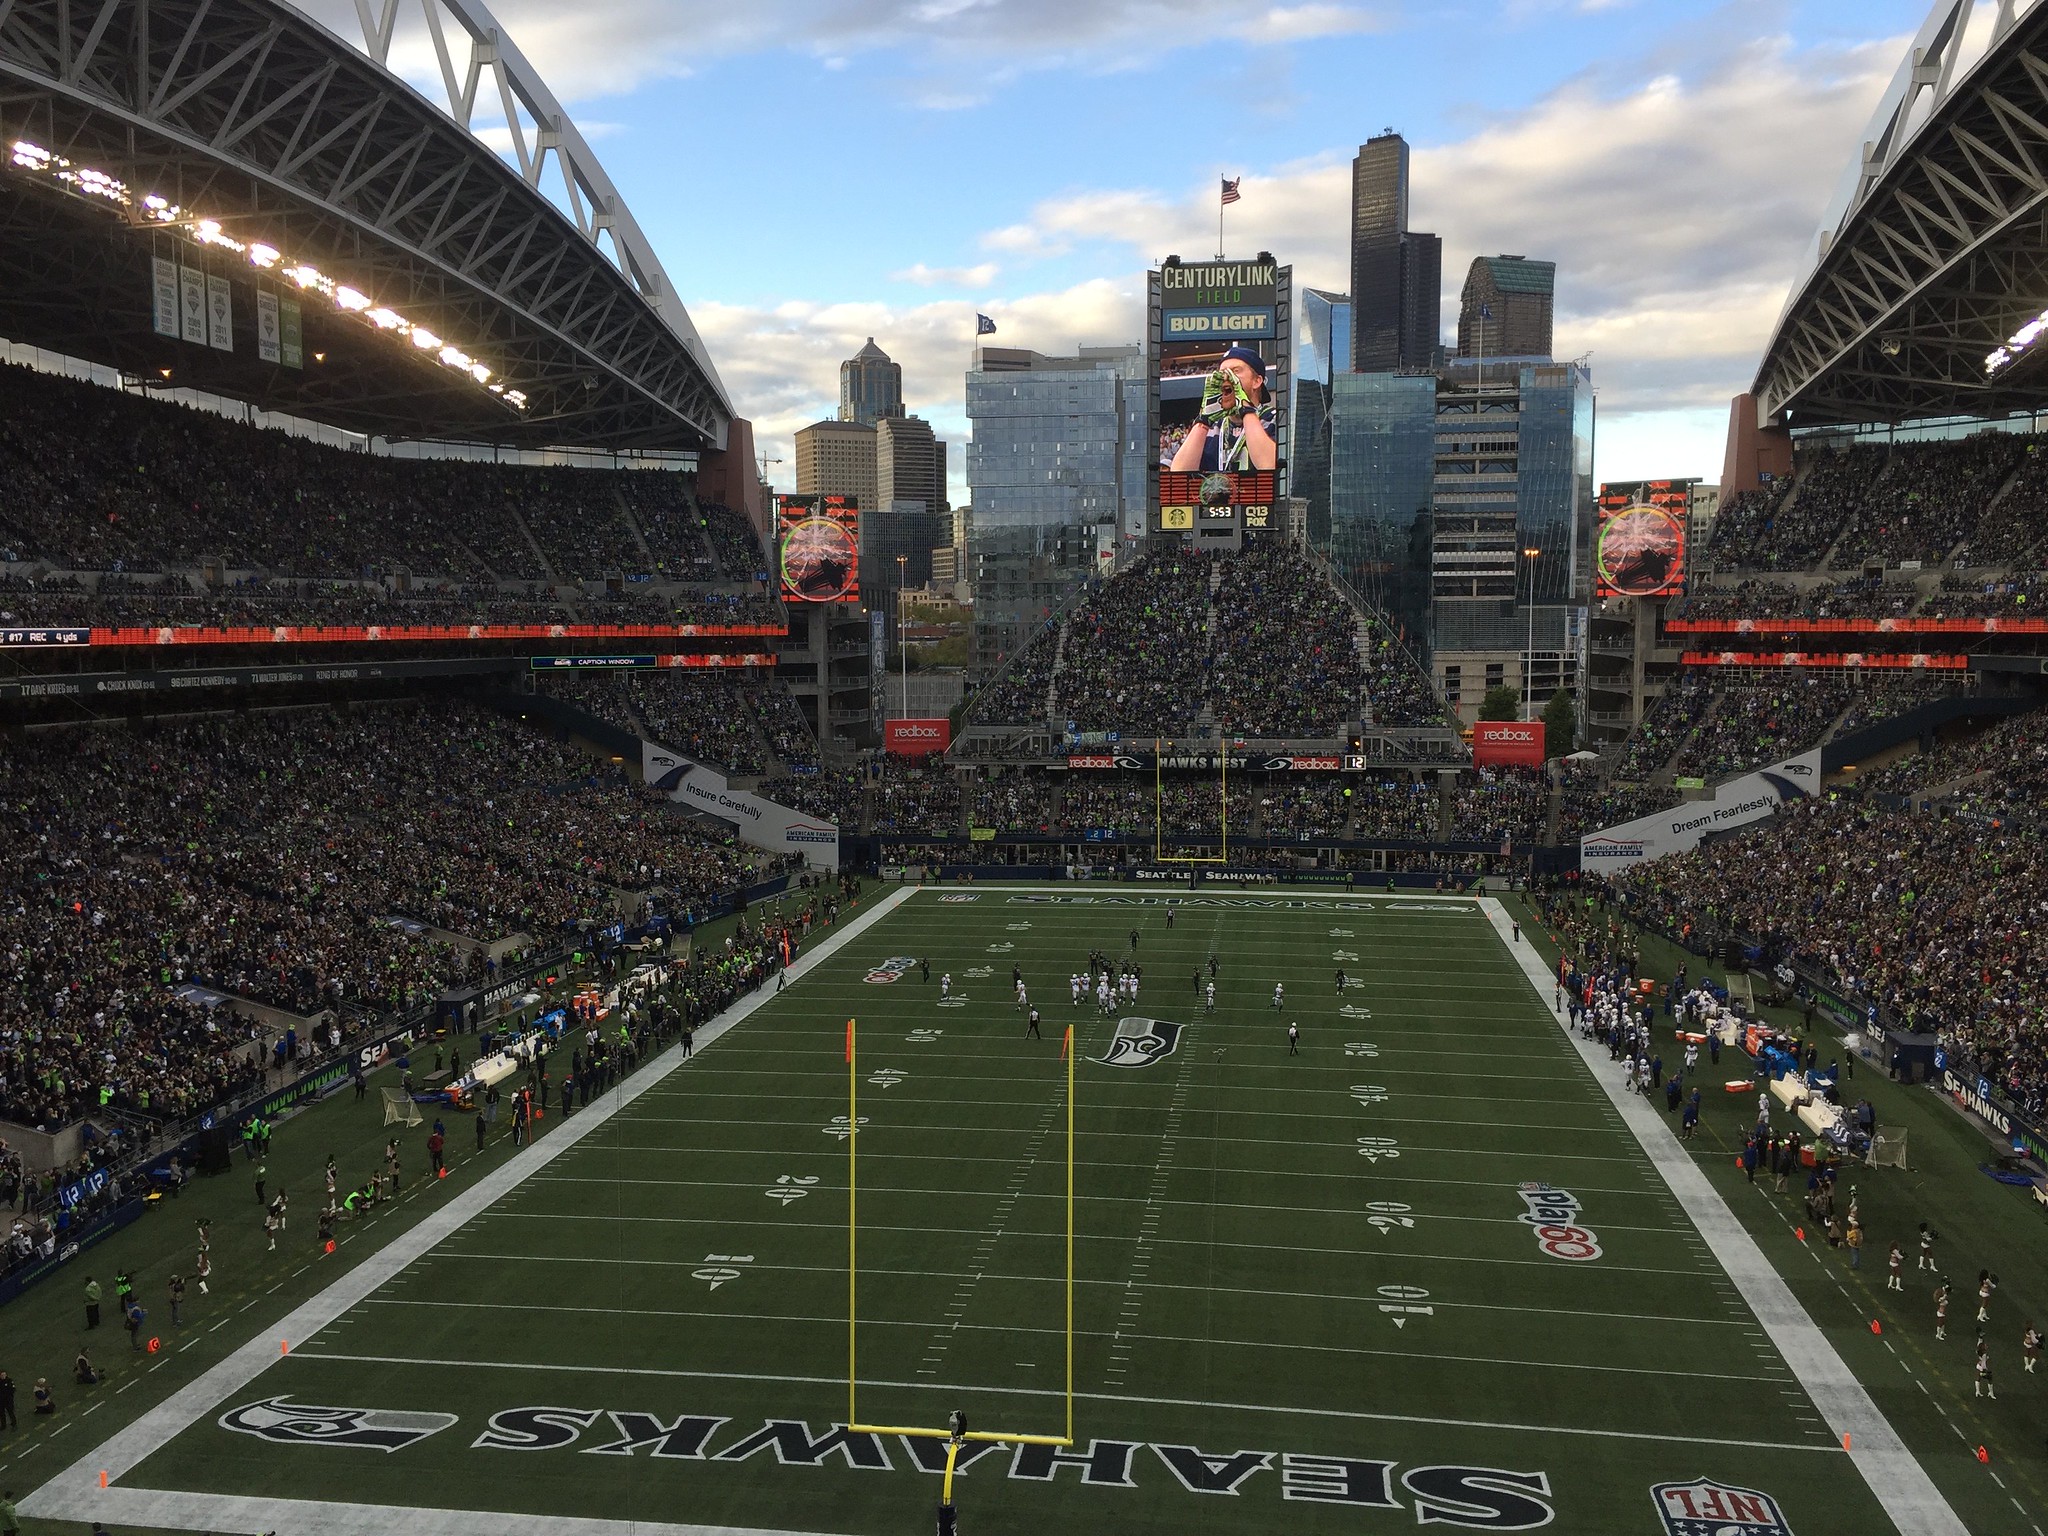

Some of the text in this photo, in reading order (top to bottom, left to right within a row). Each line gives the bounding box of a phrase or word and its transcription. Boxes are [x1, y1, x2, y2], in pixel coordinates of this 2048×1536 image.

[1197, 290, 1241, 303] FIELD
[1171, 315, 1267, 332] BUD LIGHT
[1761, 473, 1771, 481] 12
[1209, 507, 1231, 517] 5:53
[1245, 506, 1268, 517] Q13
[1247, 517, 1267, 527] FOX
[1953, 561, 1965, 570] 12
[9, 633, 23, 642] #17
[29, 633, 47, 642] REC
[56, 633, 62, 641] 4
[63, 633, 77, 643] yds
[316, 670, 359, 680] RING OF HONOR
[21, 685, 30, 696] 17
[31, 684, 46, 695] DAVE
[47, 683, 65, 695] KRIEG
[1159, 757, 1247, 769] HAWKS NEST
[1352, 757, 1364, 768] 12
[686, 782, 763, 821] Insure Carefully
[1672, 795, 1774, 835] Dream Fearlessly
[1300, 832, 1310, 841] 12
[1977, 1079, 1989, 1100] 12
[1944, 1070, 2010, 1135] SEAHAWKS
[1356, 1136, 1400, 1158] 30
[89, 1173, 104, 1196] 12
[764, 1174, 820, 1198] 20
[1365, 1201, 1415, 1229] 20
[691, 1254, 755, 1282] 10
[1376, 1285, 1434, 1316] 10
[470, 1405, 1556, 1531] SEAHAWKS
[1664, 1487, 1772, 1523] NFL
